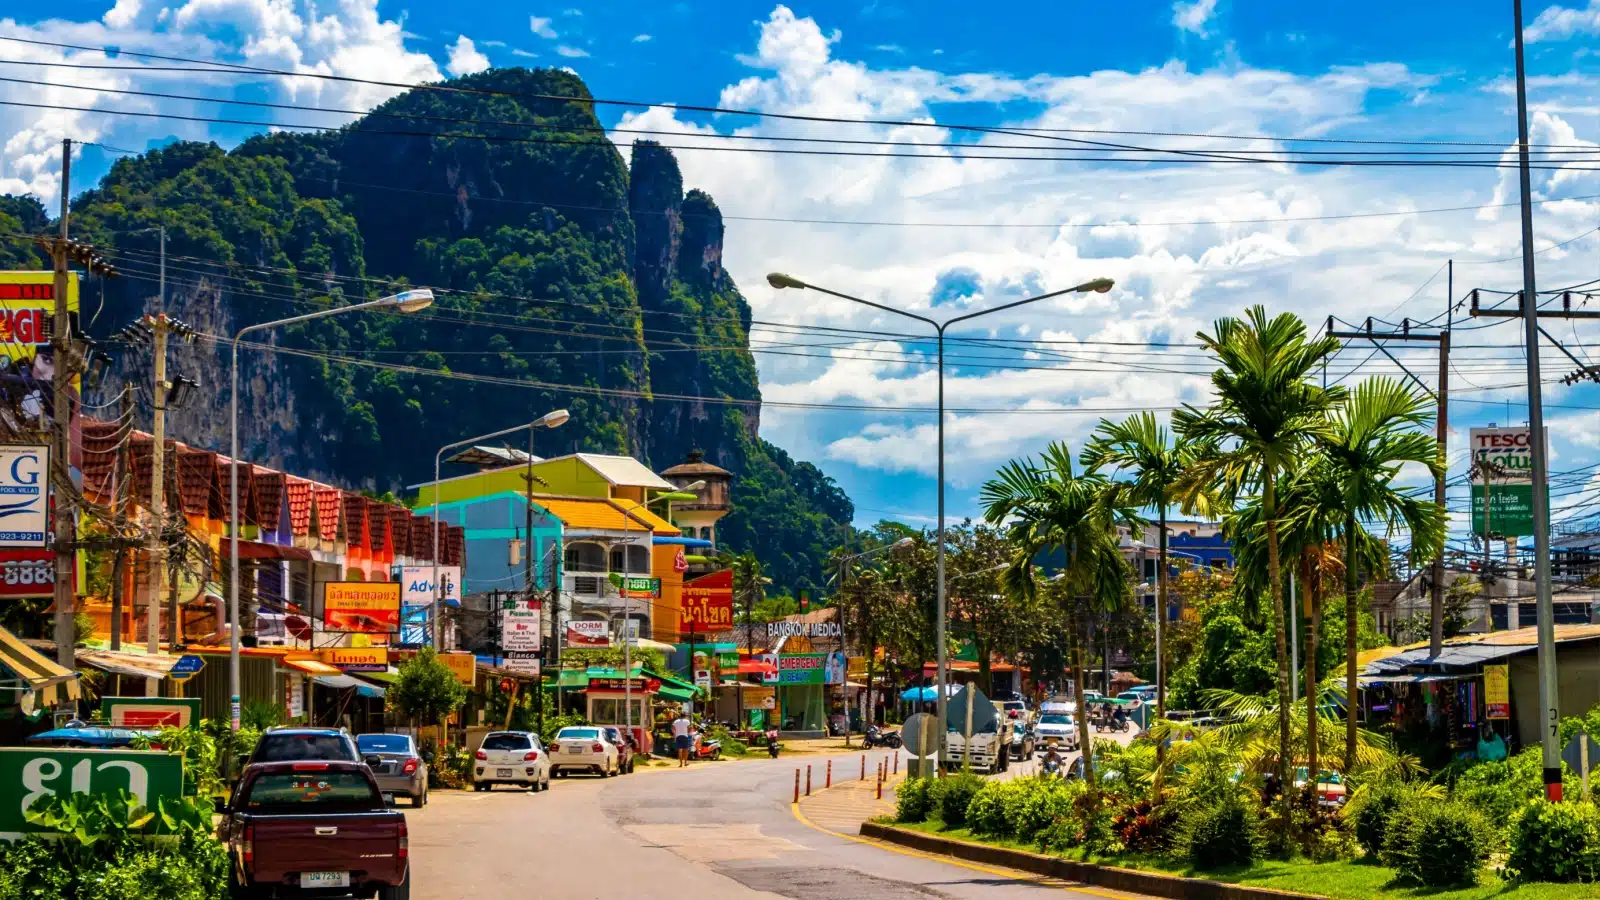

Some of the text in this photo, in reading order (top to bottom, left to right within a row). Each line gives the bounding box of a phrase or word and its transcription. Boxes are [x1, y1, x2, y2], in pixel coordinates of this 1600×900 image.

[1476, 434, 1531, 447] TESC
[1479, 452, 1532, 469] Lotu
[408, 580, 454, 593] Adve
[680, 597, 730, 624] นำโชค
[767, 623, 807, 637] BANGKOK
[780, 657, 825, 670] EMERGENCY
[321, 872, 341, 880] 7293
